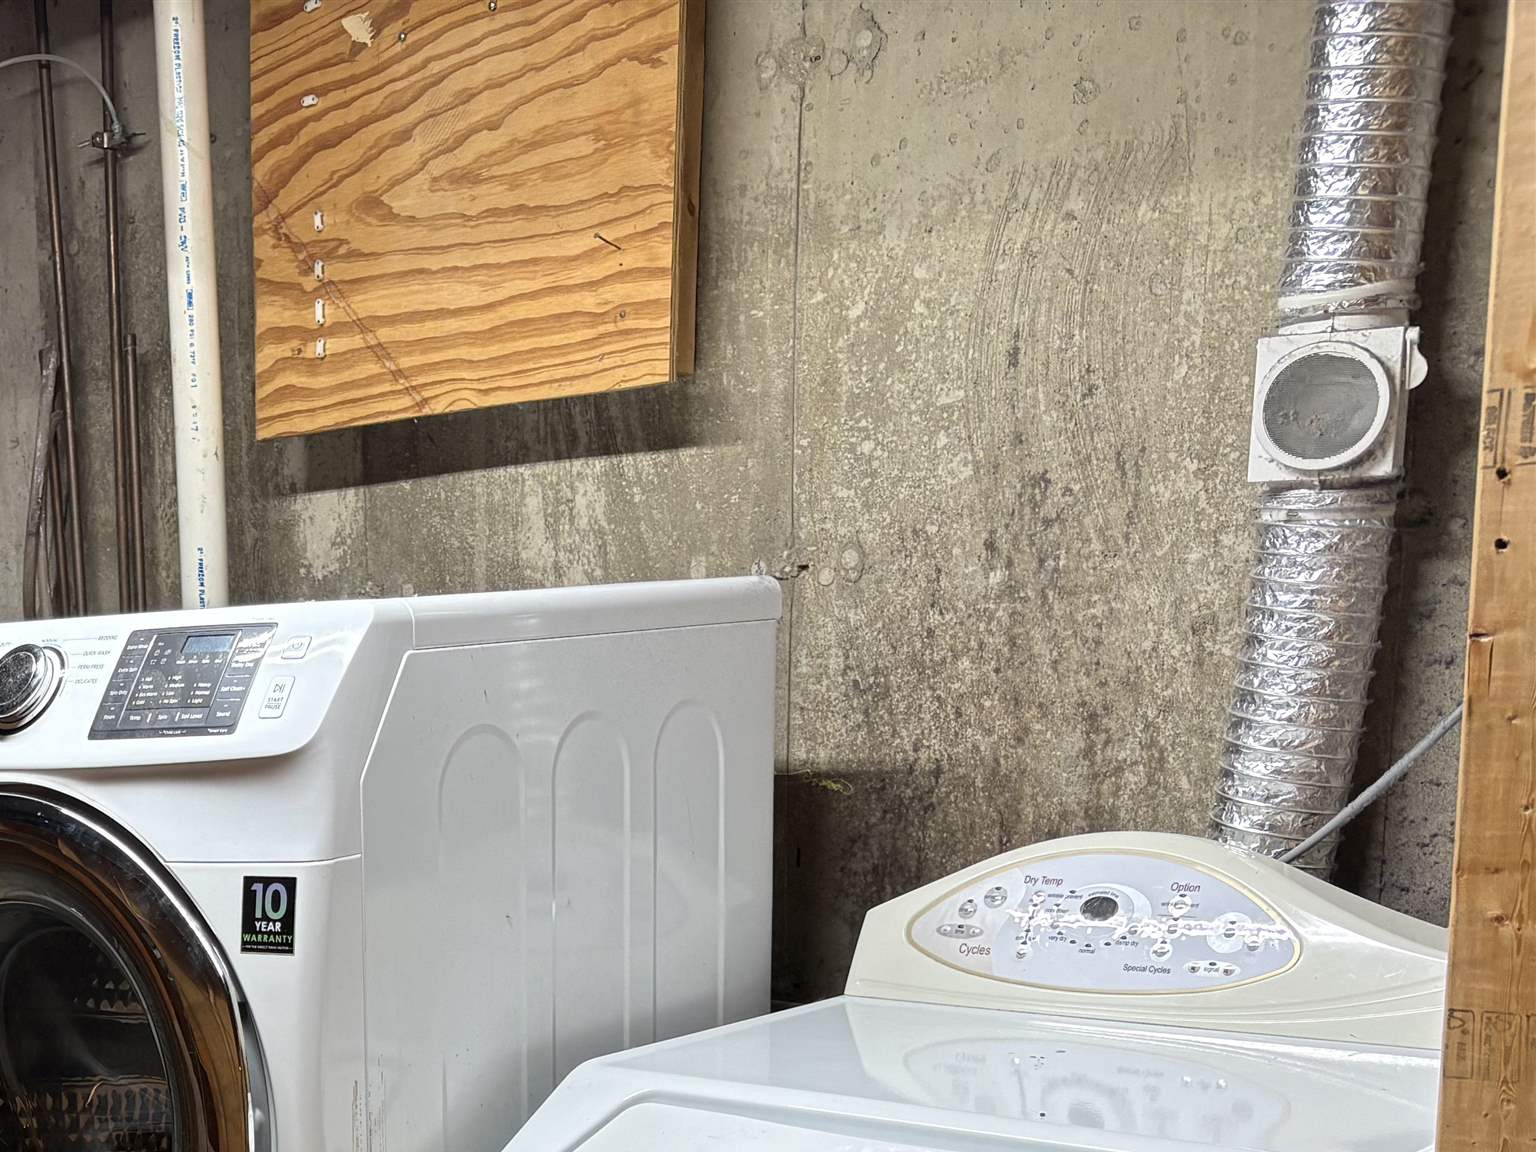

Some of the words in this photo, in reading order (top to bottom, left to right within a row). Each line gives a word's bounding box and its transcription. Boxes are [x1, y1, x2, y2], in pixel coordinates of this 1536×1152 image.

[197, 557, 205, 588] FREEDOM
[1023, 875, 1039, 886] Dry
[1041, 875, 1064, 887] Temp
[1170, 881, 1201, 894] Option
[250, 882, 288, 920] 10
[254, 921, 282, 932] YEAR
[242, 933, 293, 944] WARRANTY
[958, 942, 992, 956] Cycles
[1122, 963, 1149, 973] Special
[1150, 965, 1171, 974] Cycles
